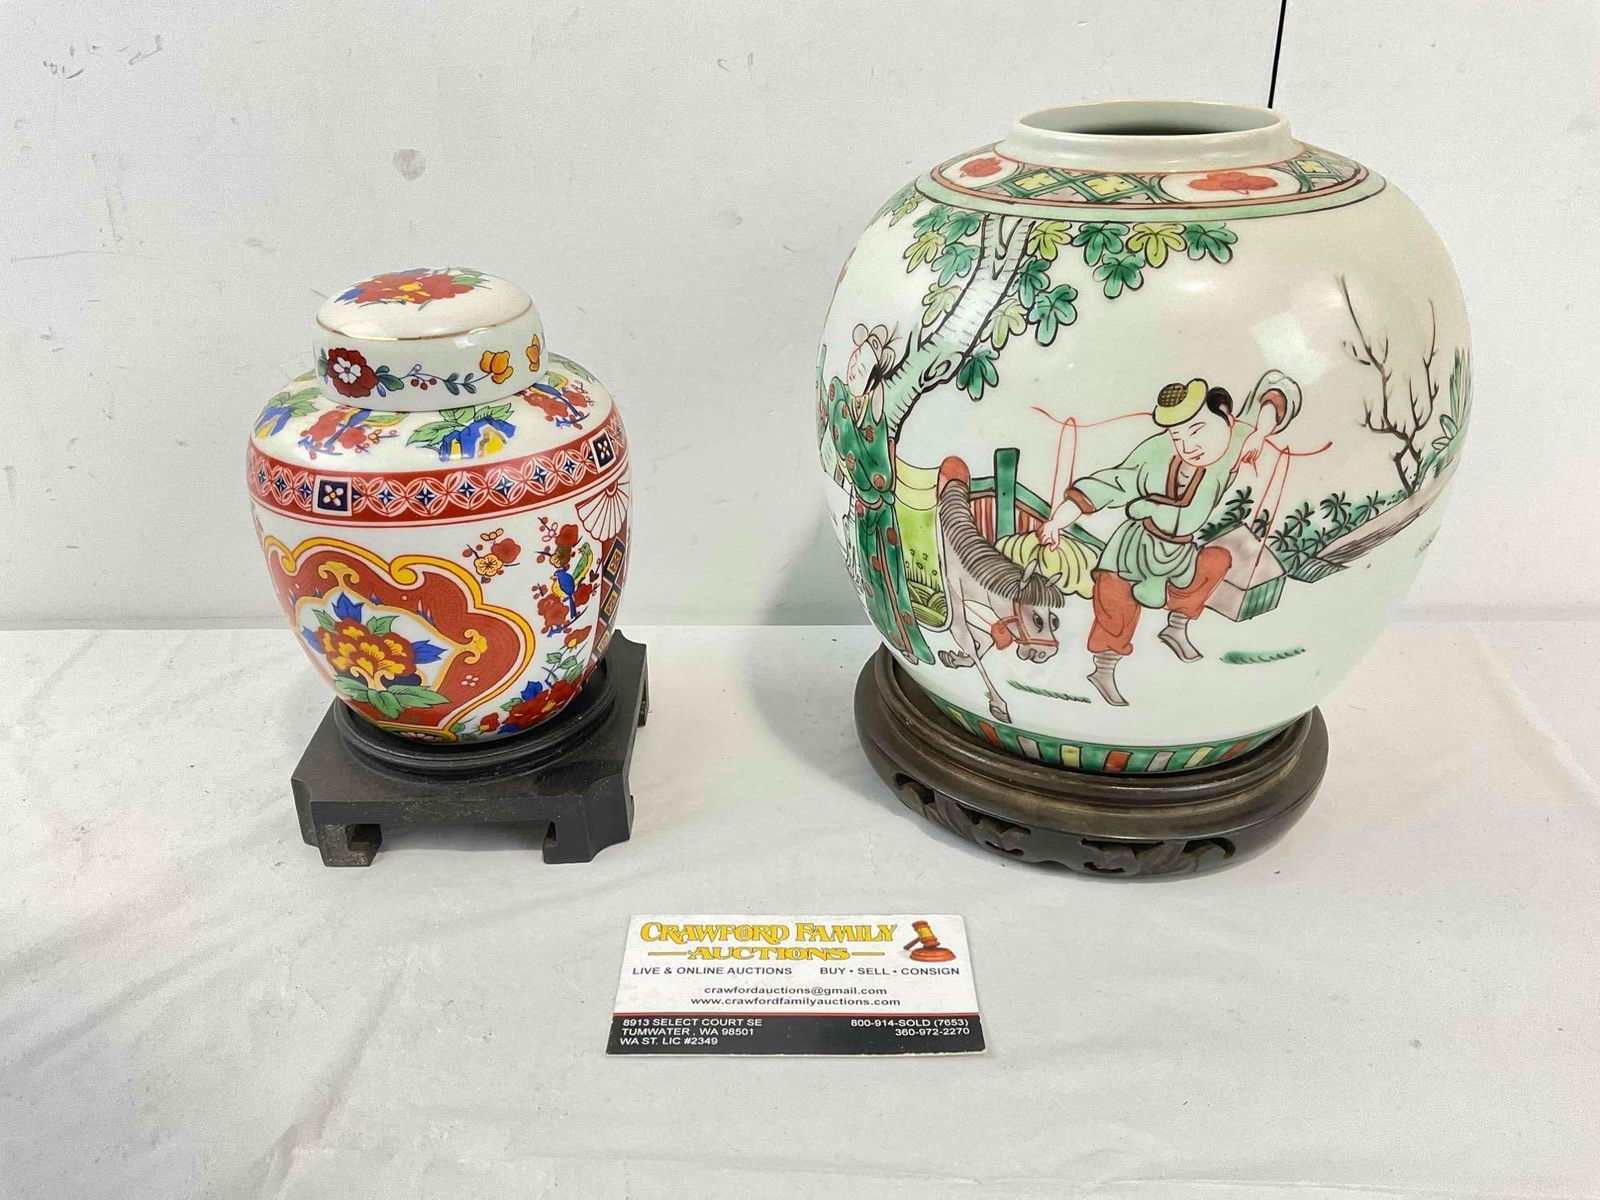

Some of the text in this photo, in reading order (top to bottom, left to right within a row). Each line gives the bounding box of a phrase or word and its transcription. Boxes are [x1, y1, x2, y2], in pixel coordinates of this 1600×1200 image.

[640, 922, 898, 944] CRAWFORD FAMILY
[687, 946, 850, 960] AUCTIONS
[632, 967, 793, 975] LIVE & ONLINE AUCTIONS
[820, 967, 960, 976] BUY SELL CONSIGN
[704, 986, 888, 996] crawfordauctions@gmail.com
[690, 997, 901, 1007] www.crawfordfamilyauctions.com
[622, 1018, 763, 1027] 8913 SELECT COURT SE
[850, 1018, 969, 1028] 800-914-SOLD (7653)
[699, 1028, 719, 1036] WA
[721, 1028, 754, 1036] 98501
[894, 1027, 970, 1036] 360-972-2270
[620, 1037, 719, 1046] WA ST. LIC #2349
